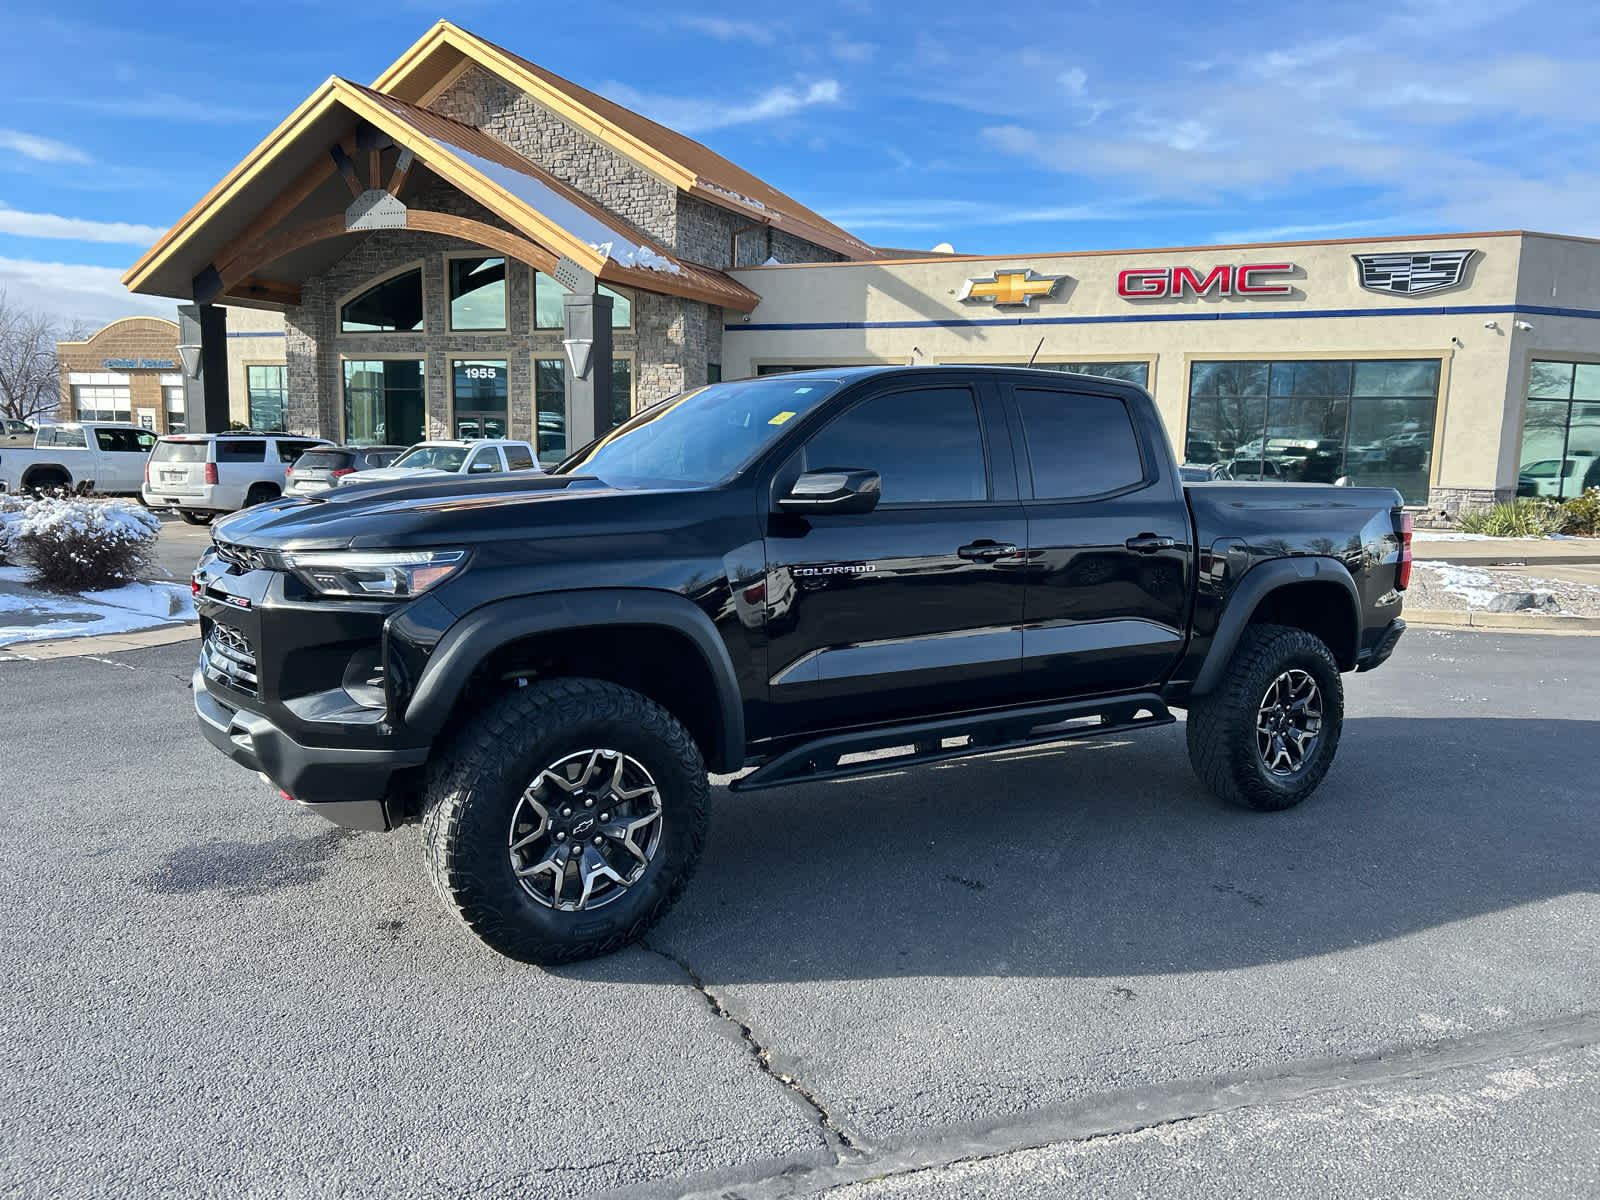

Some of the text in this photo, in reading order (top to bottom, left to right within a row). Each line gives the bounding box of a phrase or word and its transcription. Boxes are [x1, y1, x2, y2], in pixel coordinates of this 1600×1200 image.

[1116, 263, 1294, 299] GMC
[464, 367, 497, 379] 1955
[793, 564, 876, 577] COLORADO
